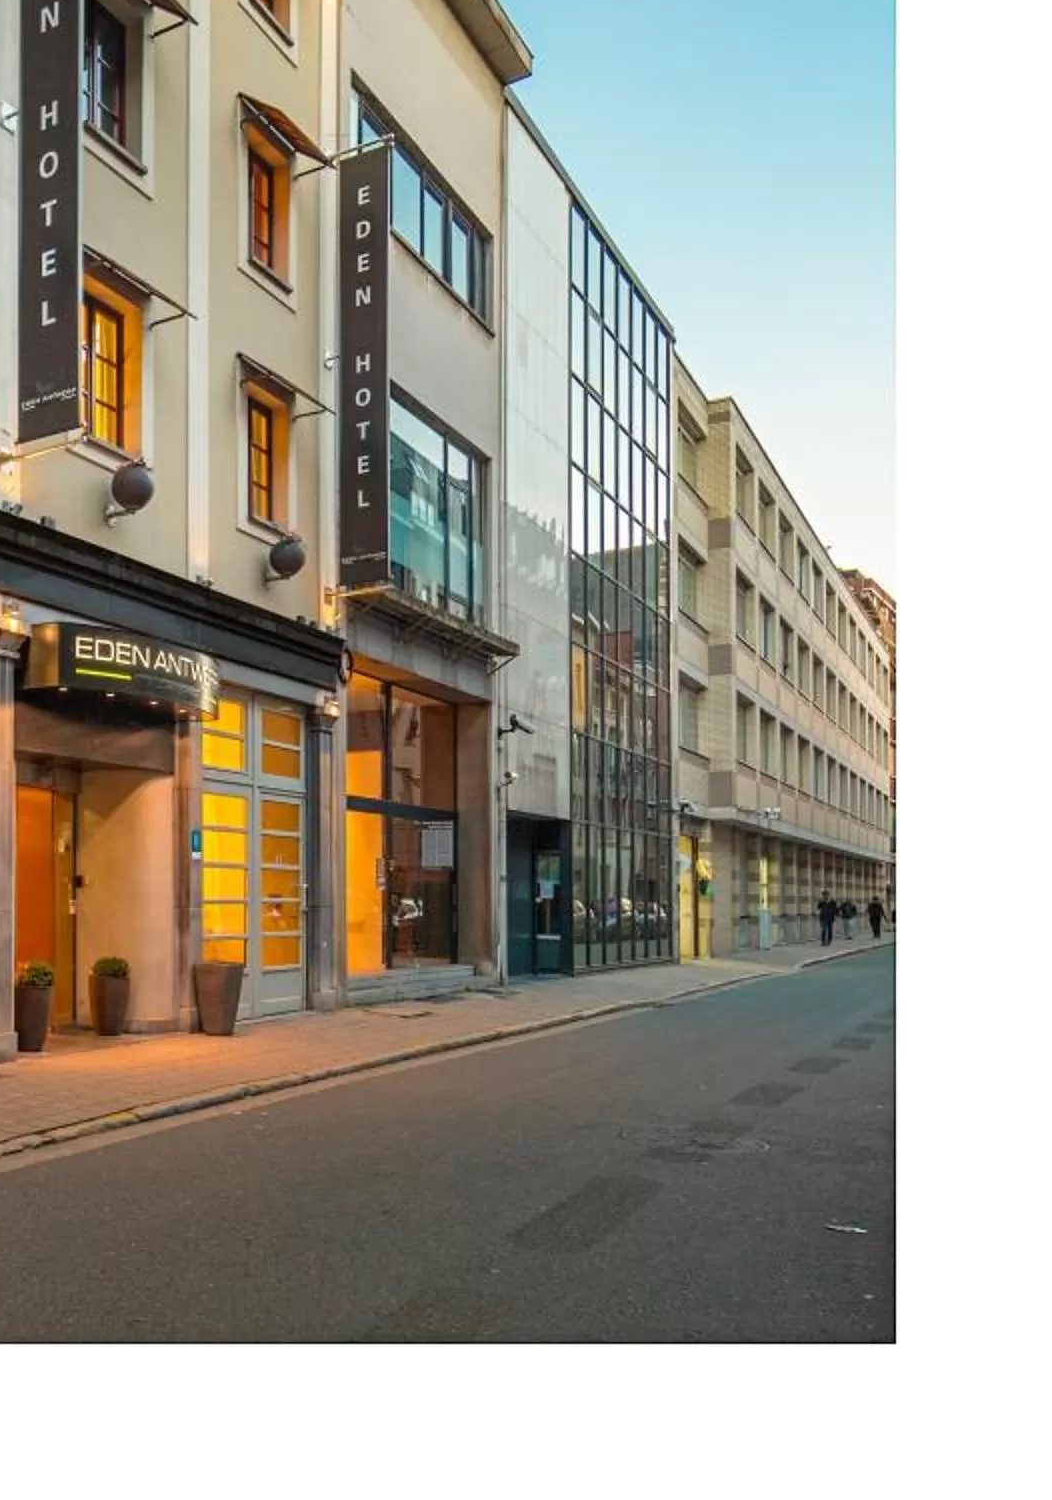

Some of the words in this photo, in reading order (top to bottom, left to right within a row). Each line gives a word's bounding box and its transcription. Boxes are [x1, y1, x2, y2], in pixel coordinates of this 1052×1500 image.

[39, 100, 59, 327] HOTEL
[355, 185, 371, 307] EDEN
[355, 353, 371, 508] HOTEL
[75, 636, 150, 669] EDEN
